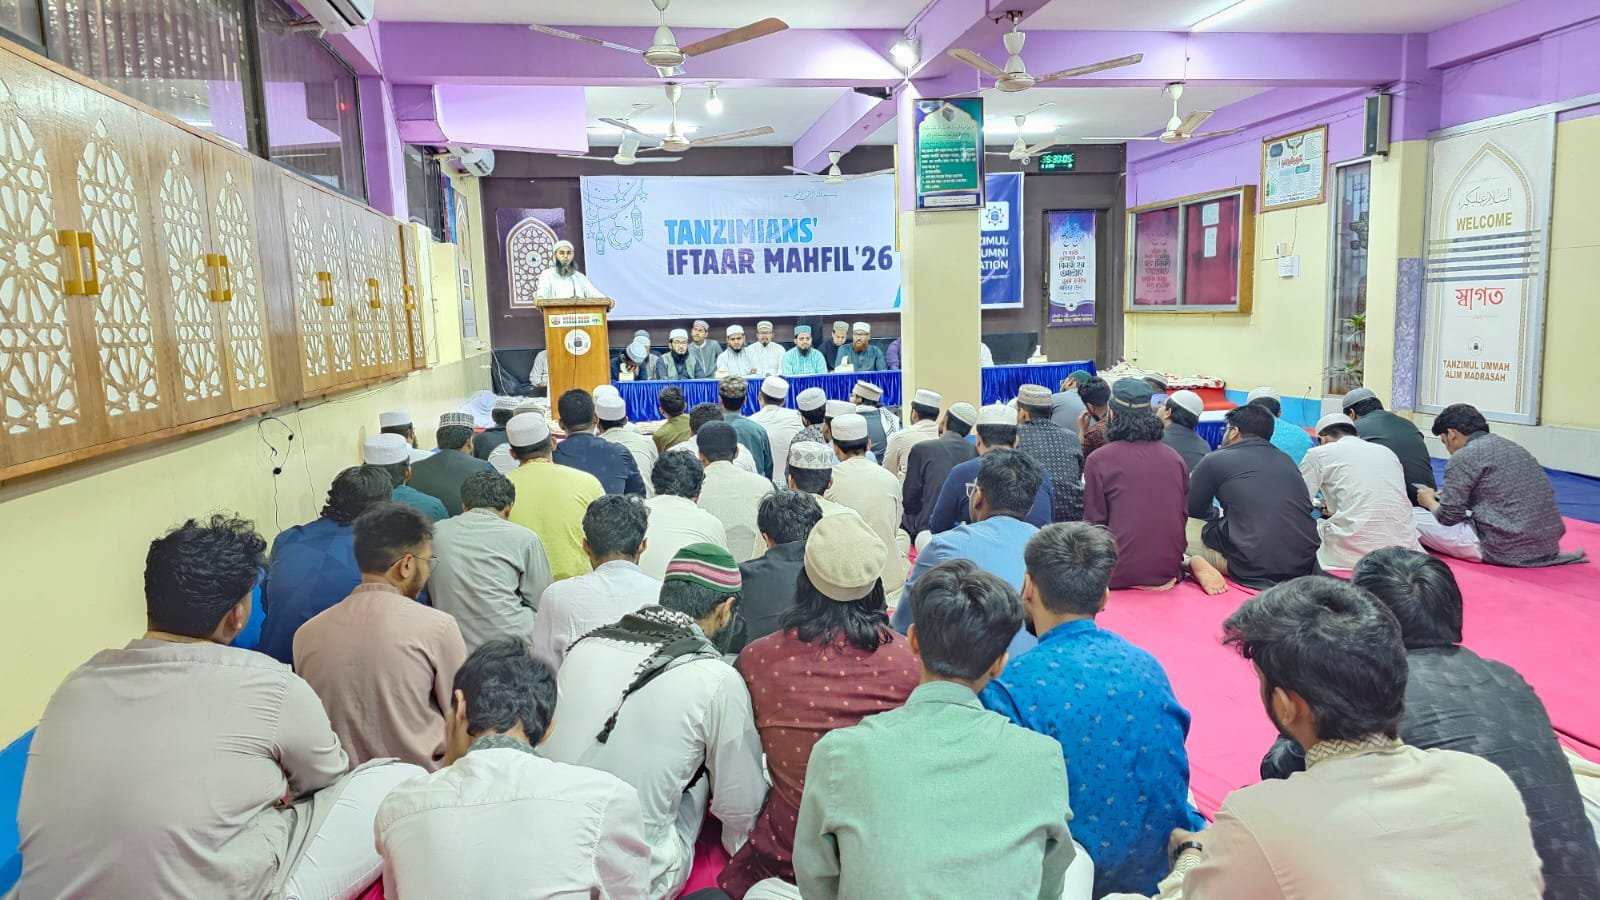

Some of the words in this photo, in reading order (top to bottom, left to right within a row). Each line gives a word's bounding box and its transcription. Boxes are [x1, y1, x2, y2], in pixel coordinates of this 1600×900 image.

[664, 217, 818, 245] TANZIMIANS'
[1456, 212, 1512, 231] WELCOME
[981, 236, 1009, 246] IMUL
[667, 248, 755, 275] IFTAAR
[1455, 287, 1505, 310] স্বাগত
[1443, 360, 1479, 369] TANZIMUL
[1481, 362, 1510, 371] UMMAH
[1445, 366, 1462, 378] ALIM
[1464, 371, 1506, 382] MADRASAH
